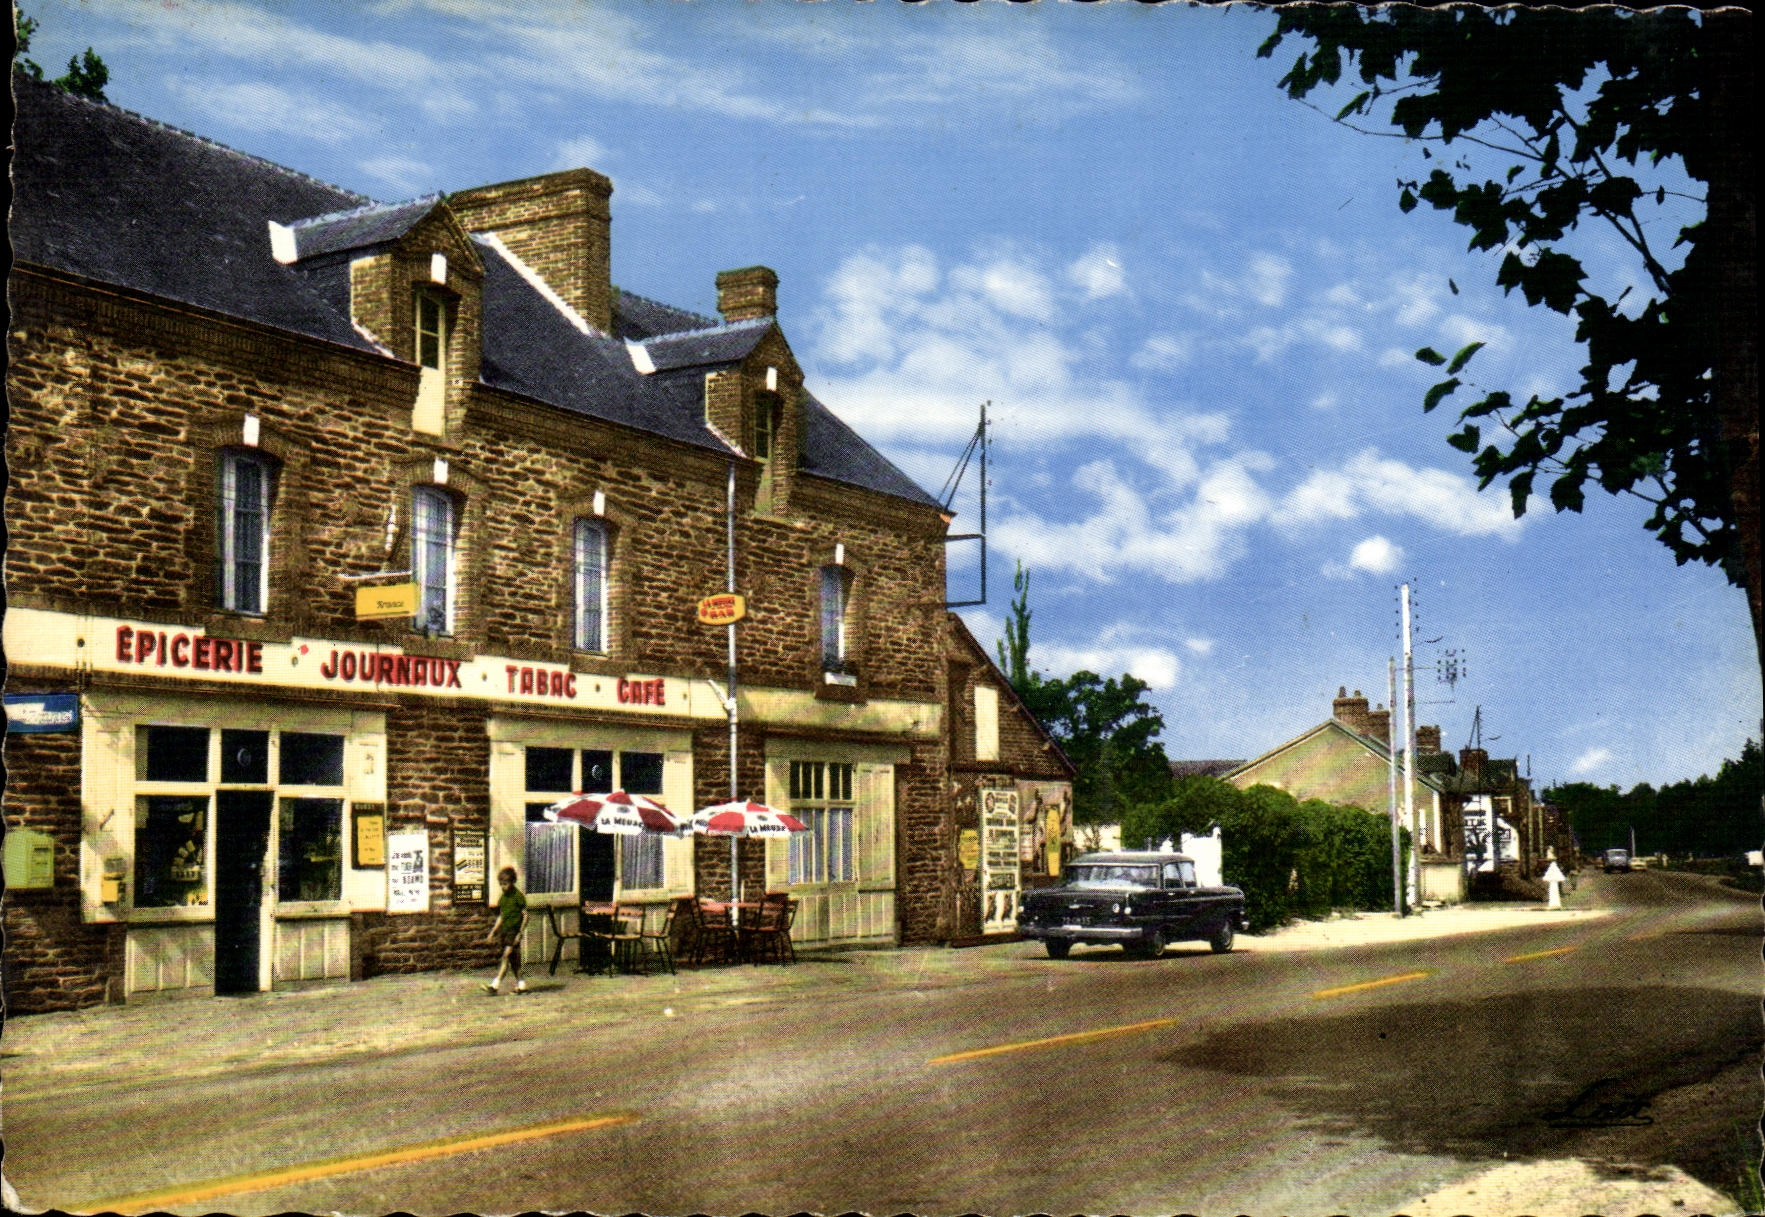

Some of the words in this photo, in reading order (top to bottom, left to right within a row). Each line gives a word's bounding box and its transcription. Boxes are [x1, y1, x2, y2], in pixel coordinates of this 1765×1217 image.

[320, 649, 462, 688] JOURNAUX
[505, 664, 577, 699] TABAC
[601, 817, 611, 826] LA
[749, 825, 758, 834] LA
